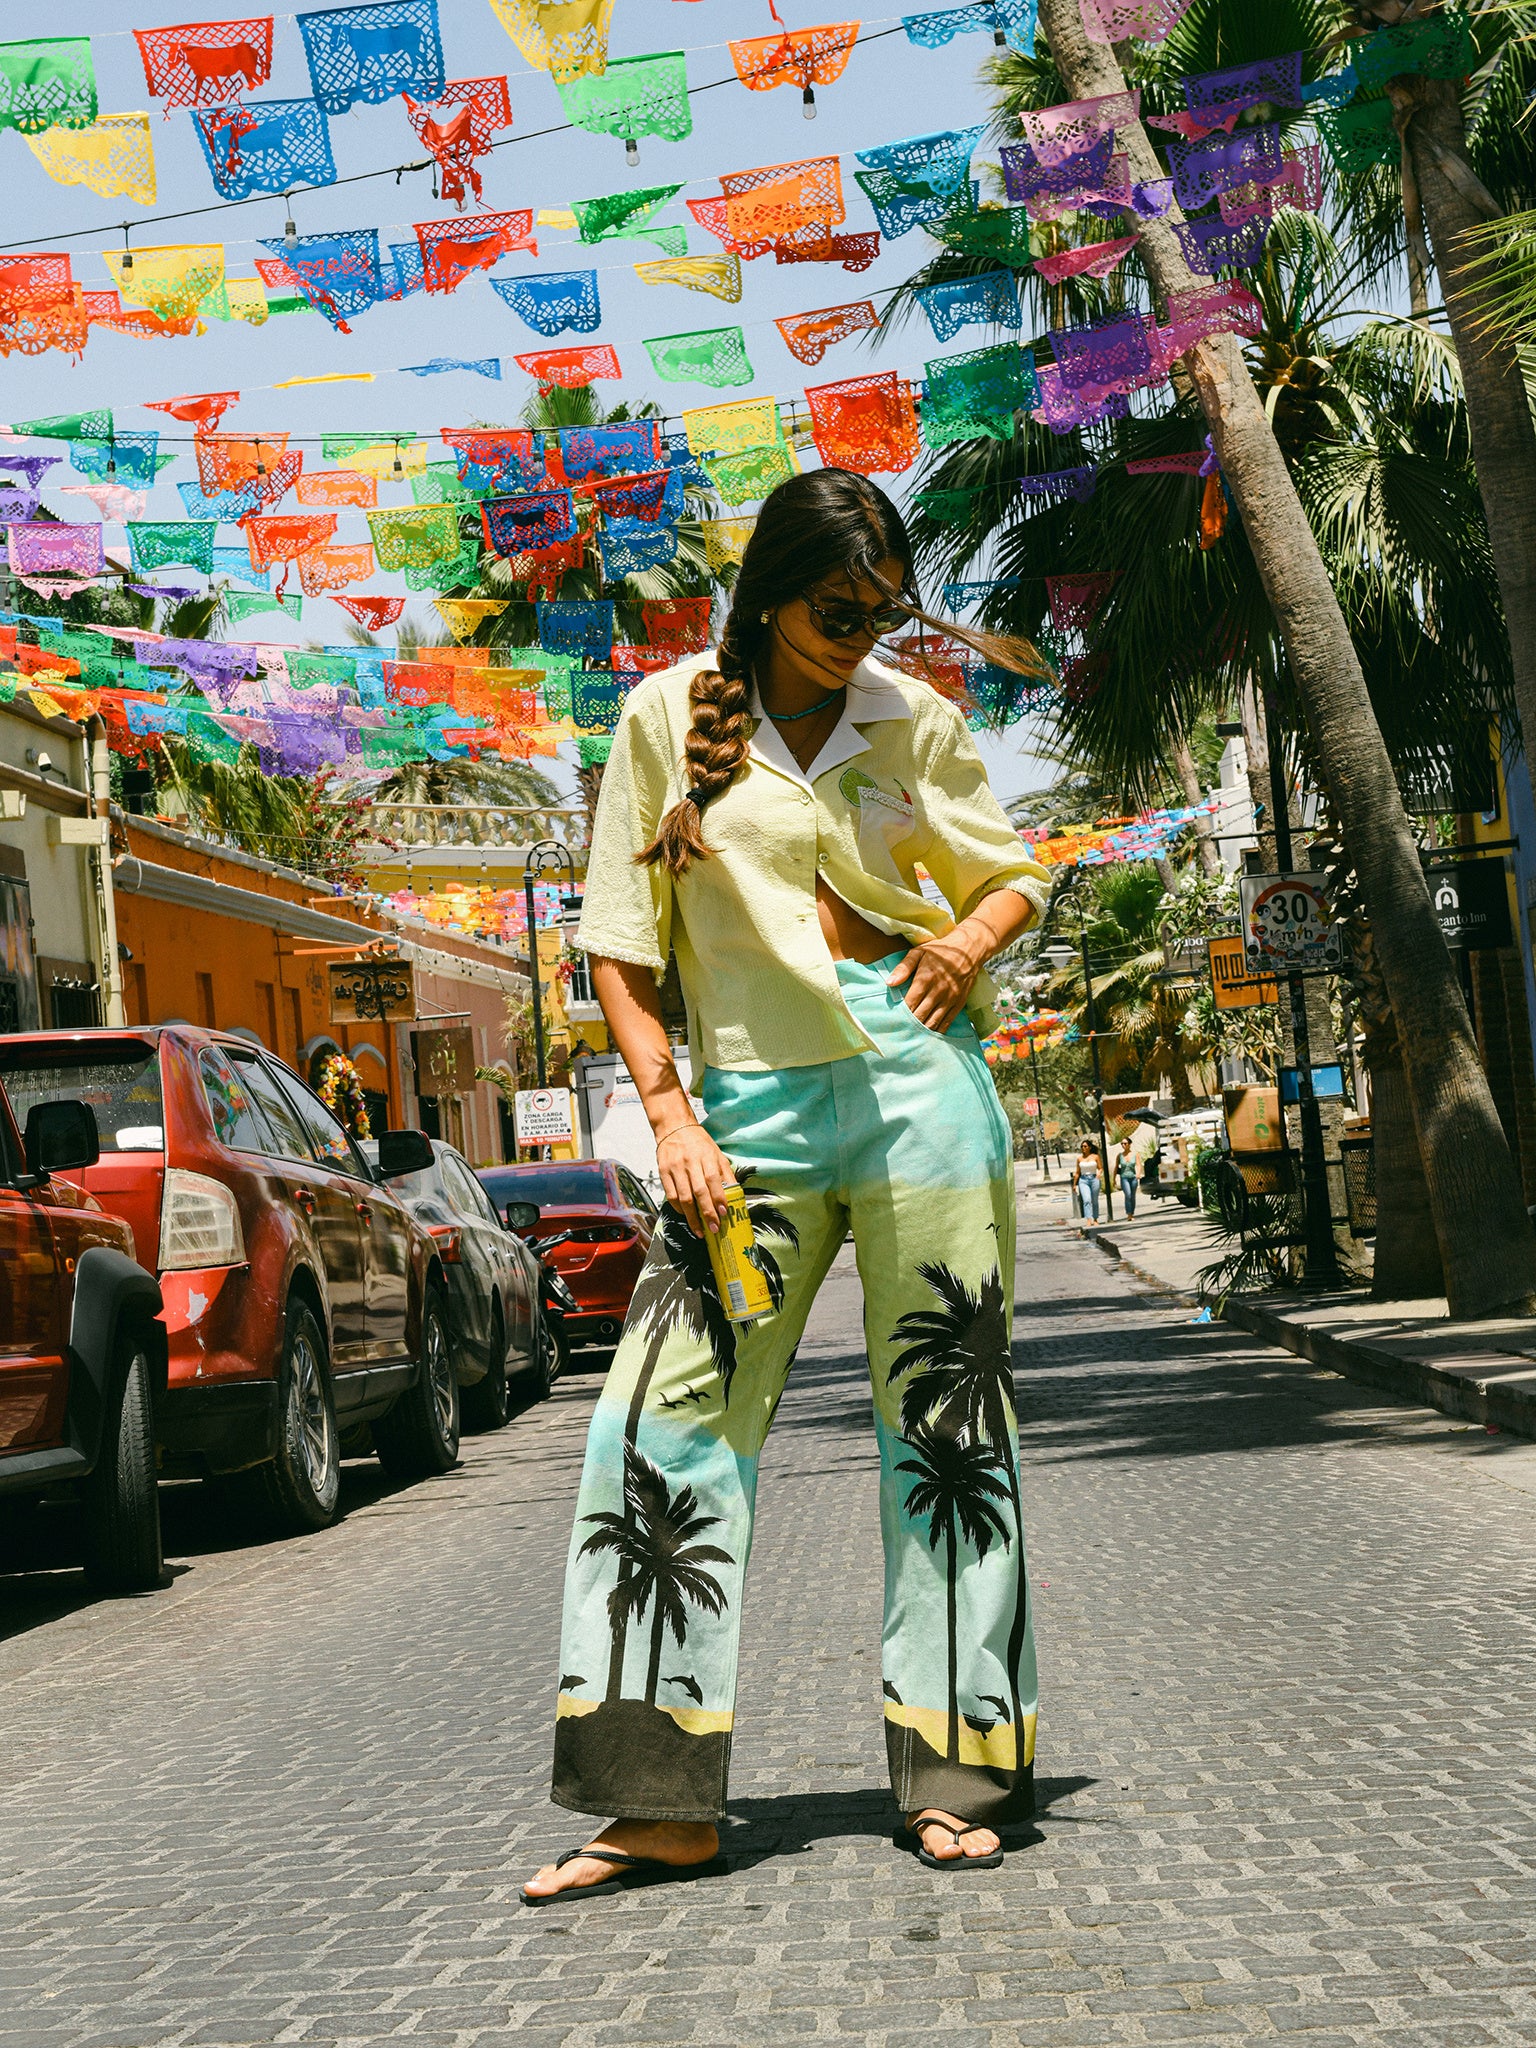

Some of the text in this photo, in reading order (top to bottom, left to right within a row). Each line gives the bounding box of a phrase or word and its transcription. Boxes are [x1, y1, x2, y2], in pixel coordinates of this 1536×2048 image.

[1271, 893, 1308, 924] 30
[1438, 912, 1487, 927] canto Inn
